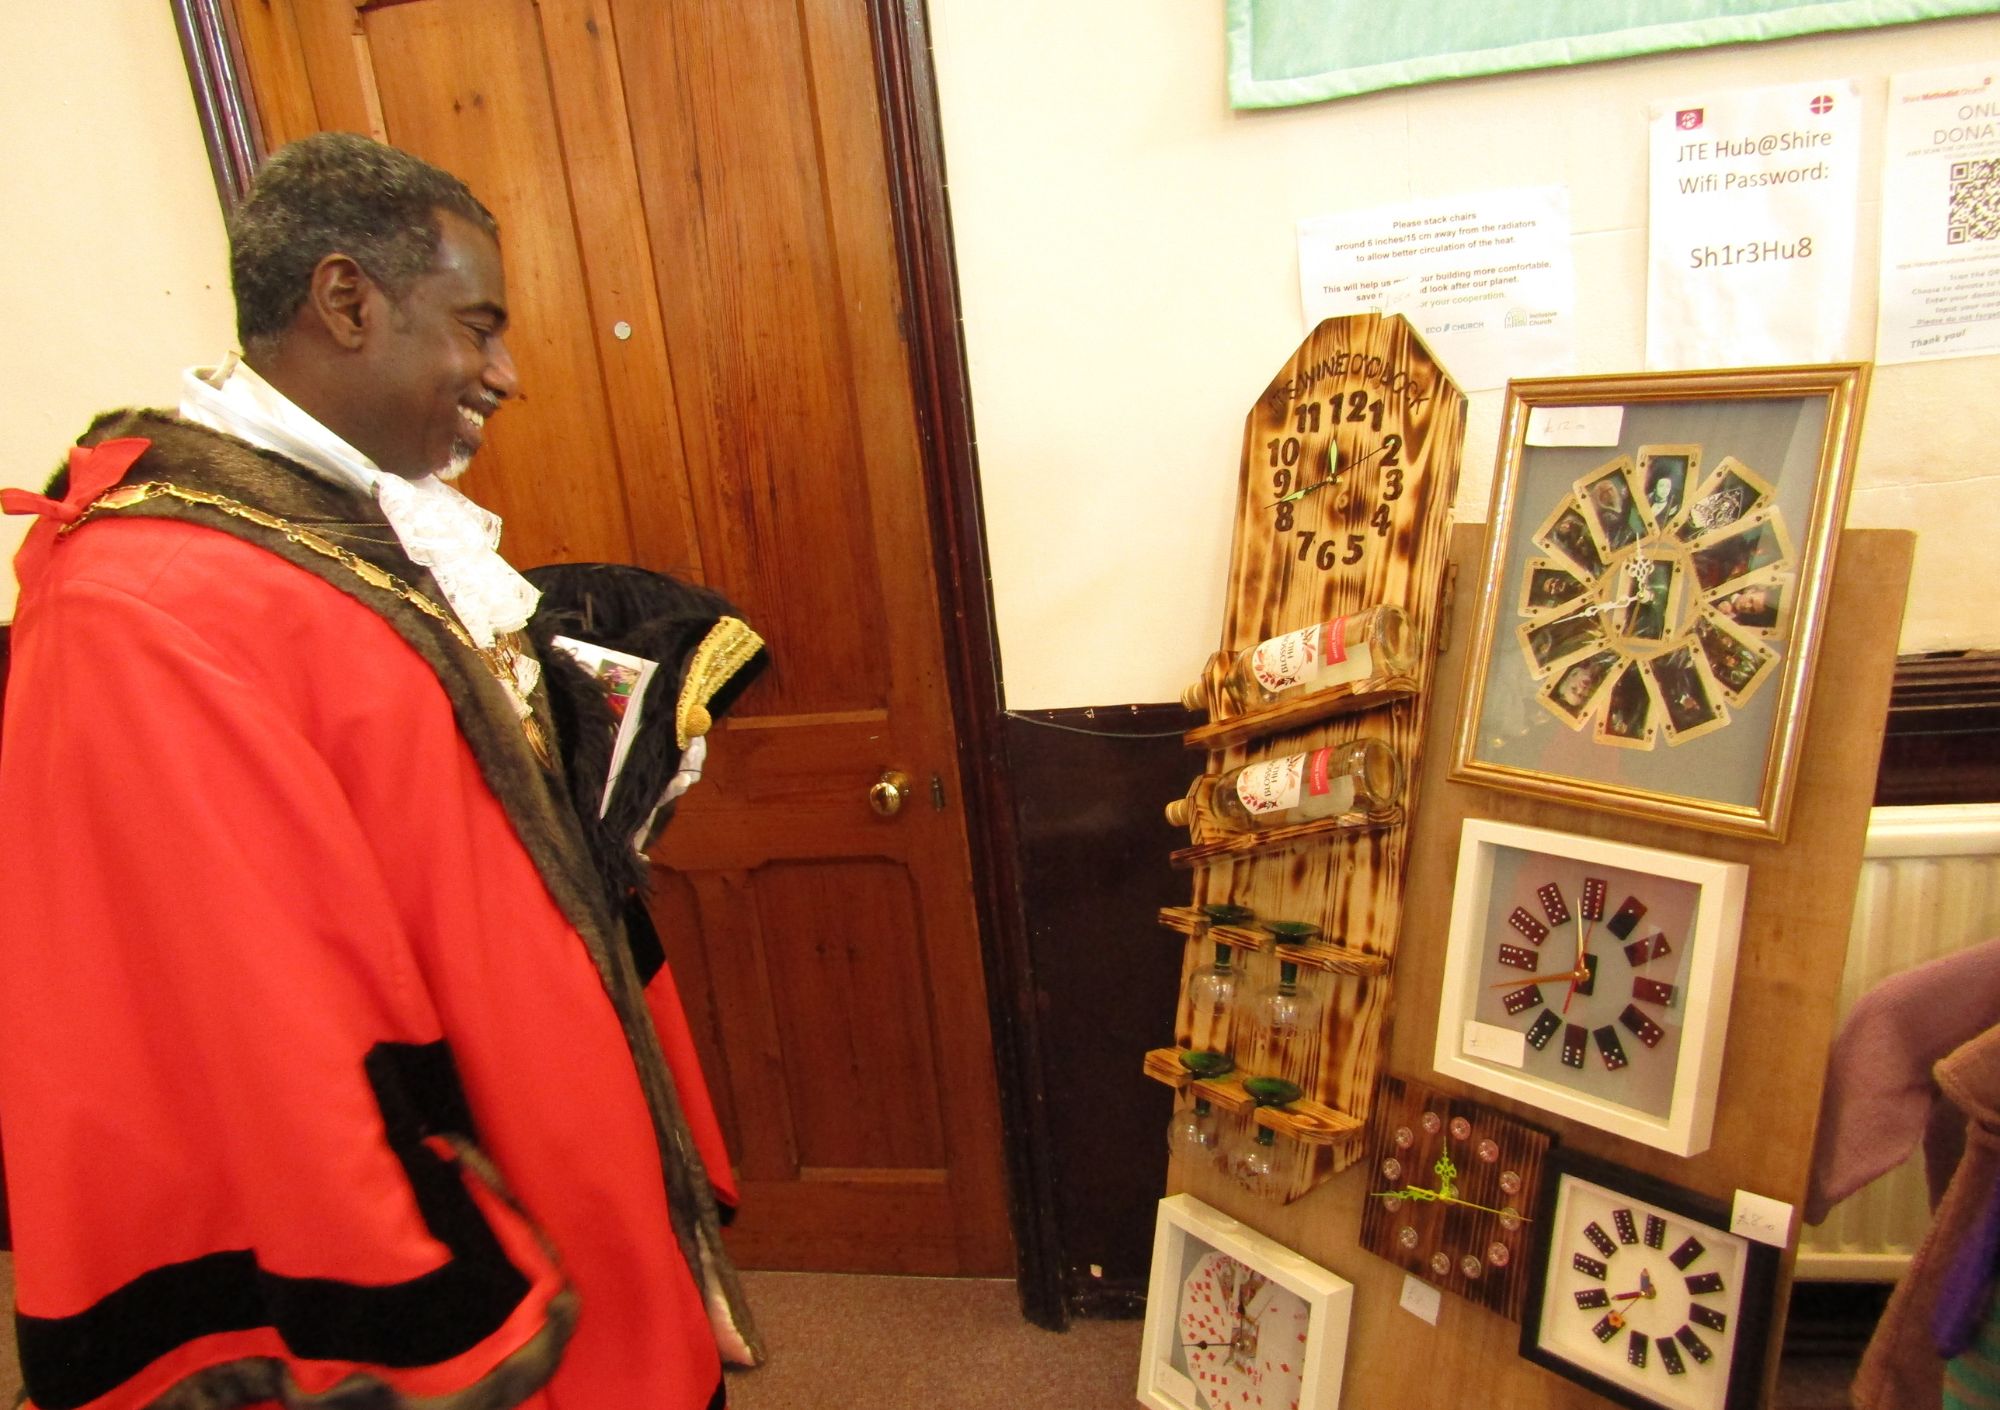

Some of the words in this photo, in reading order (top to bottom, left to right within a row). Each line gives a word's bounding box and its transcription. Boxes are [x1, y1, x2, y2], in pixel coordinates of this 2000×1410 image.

[1677, 142, 1708, 163] JTE
[1715, 130, 1832, 158] Hub@Shire
[1678, 173, 1718, 195] Wifi
[1725, 161, 1829, 190] Password:
[1335, 241, 1365, 251] around
[1375, 233, 1416, 246] inches/15
[1418, 233, 1432, 241] cm
[1434, 230, 1456, 239] away
[1459, 226, 1479, 236] from
[1481, 224, 1495, 233] the
[1497, 220, 1537, 231] radiators
[1393, 219, 1421, 229] Please
[1424, 215, 1447, 225] stack
[1449, 212, 1477, 222] chairs
[1367, 251, 1390, 261] allow
[1391, 248, 1418, 258] better
[1419, 242, 1466, 255] circulation
[1468, 240, 1477, 249] of
[1478, 238, 1492, 247] the
[1690, 236, 1813, 269] Sh1r3Hu8
[1323, 285, 1341, 294] This
[1343, 282, 1358, 292] will
[1360, 280, 1379, 290] help
[1436, 269, 1471, 281] building
[1473, 268, 1496, 276] more
[1356, 293, 1377, 301] save
[1430, 283, 1448, 293] look
[1450, 281, 1470, 291] after
[1472, 279, 1487, 288] our
[1430, 298, 1450, 308] your
[1425, 326, 1442, 334] ECO
[1451, 321, 1485, 331] CHURCH
[1299, 353, 1348, 387] WINE
[1295, 401, 1321, 433] 11
[1329, 390, 1368, 425] 12
[1369, 399, 1385, 432] 1
[1267, 437, 1300, 467] 10
[1380, 434, 1402, 467] 2
[1273, 469, 1291, 498] 9
[1383, 468, 1404, 500] 3
[1275, 502, 1294, 532] 8
[1371, 503, 1391, 537] 4
[1297, 531, 1316, 561] 7
[1316, 540, 1336, 570] 6
[1341, 534, 1365, 565] 5
